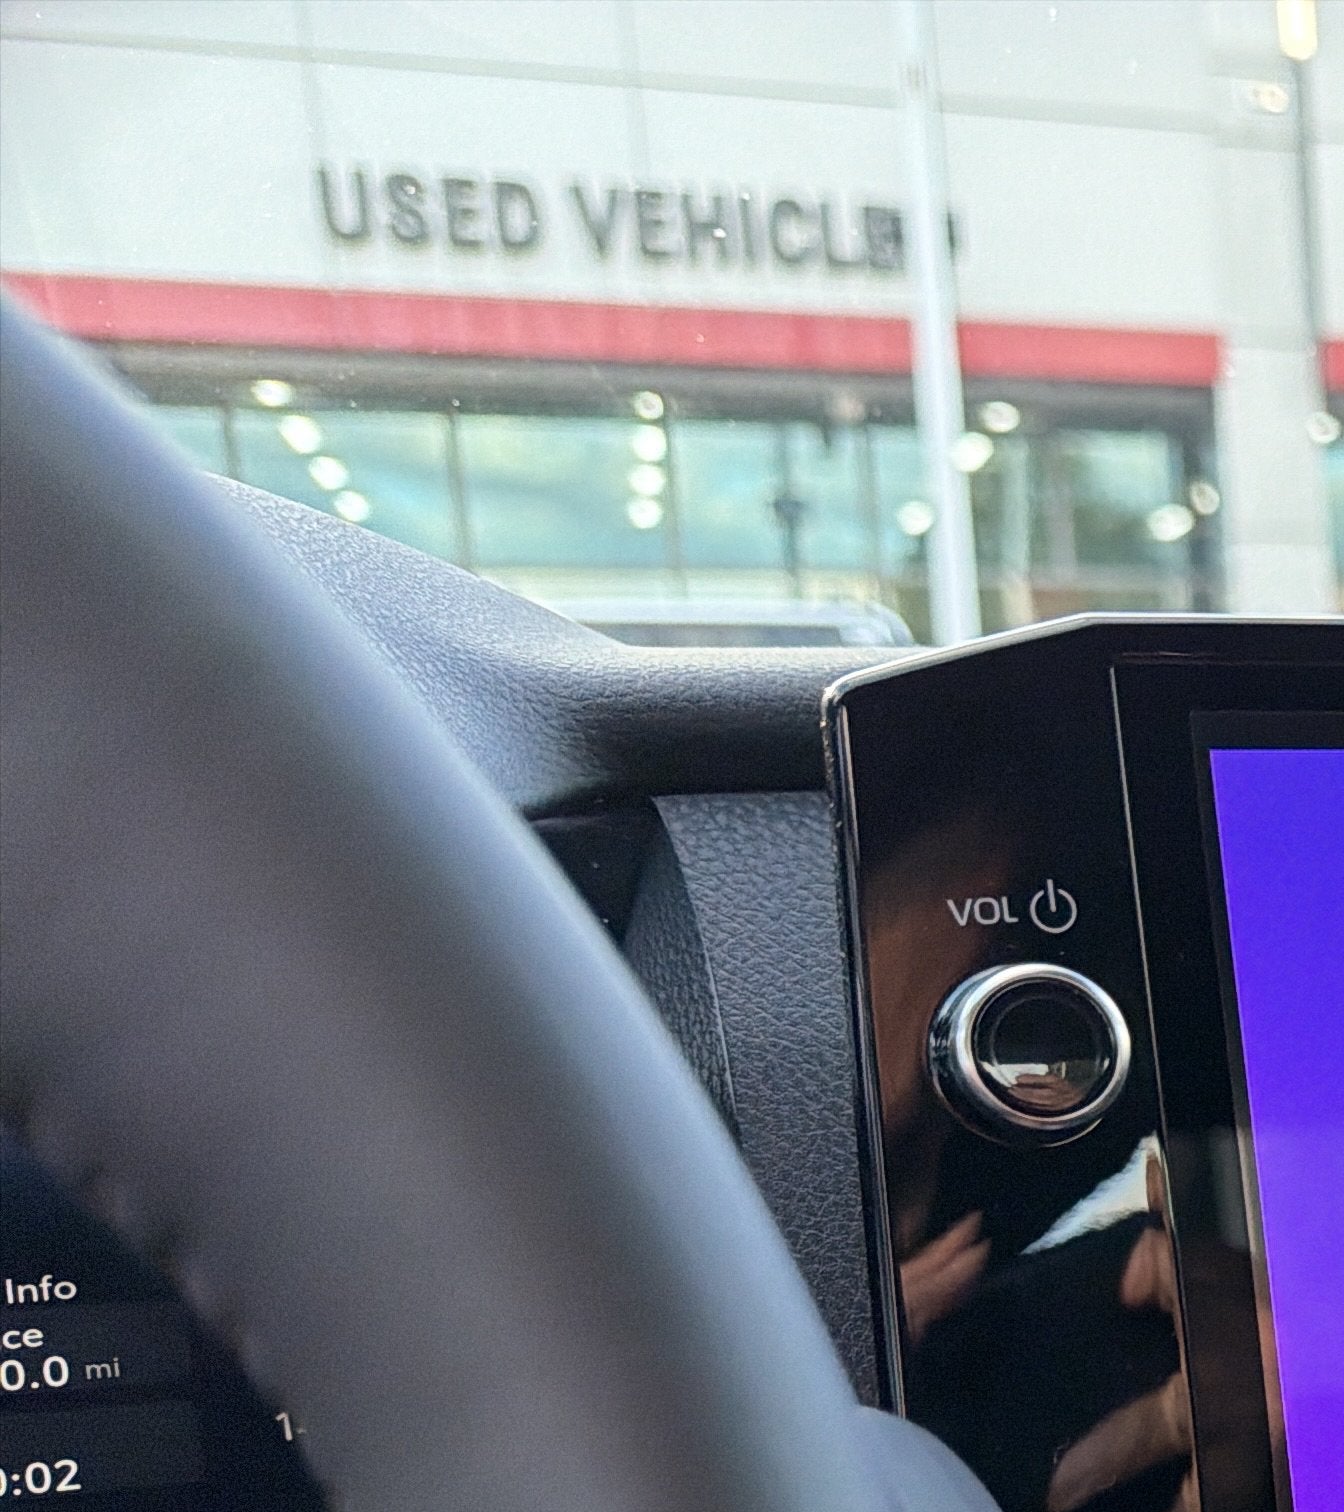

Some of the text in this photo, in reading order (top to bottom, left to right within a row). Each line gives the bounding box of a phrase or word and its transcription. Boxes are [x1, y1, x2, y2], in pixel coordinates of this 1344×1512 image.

[318, 163, 956, 271] USED VEHICLE
[946, 896, 1019, 927] VOL
[5, 1274, 77, 1304] Info
[0, 1328, 44, 1350] ce
[0, 1356, 120, 1391] 0.0 mi
